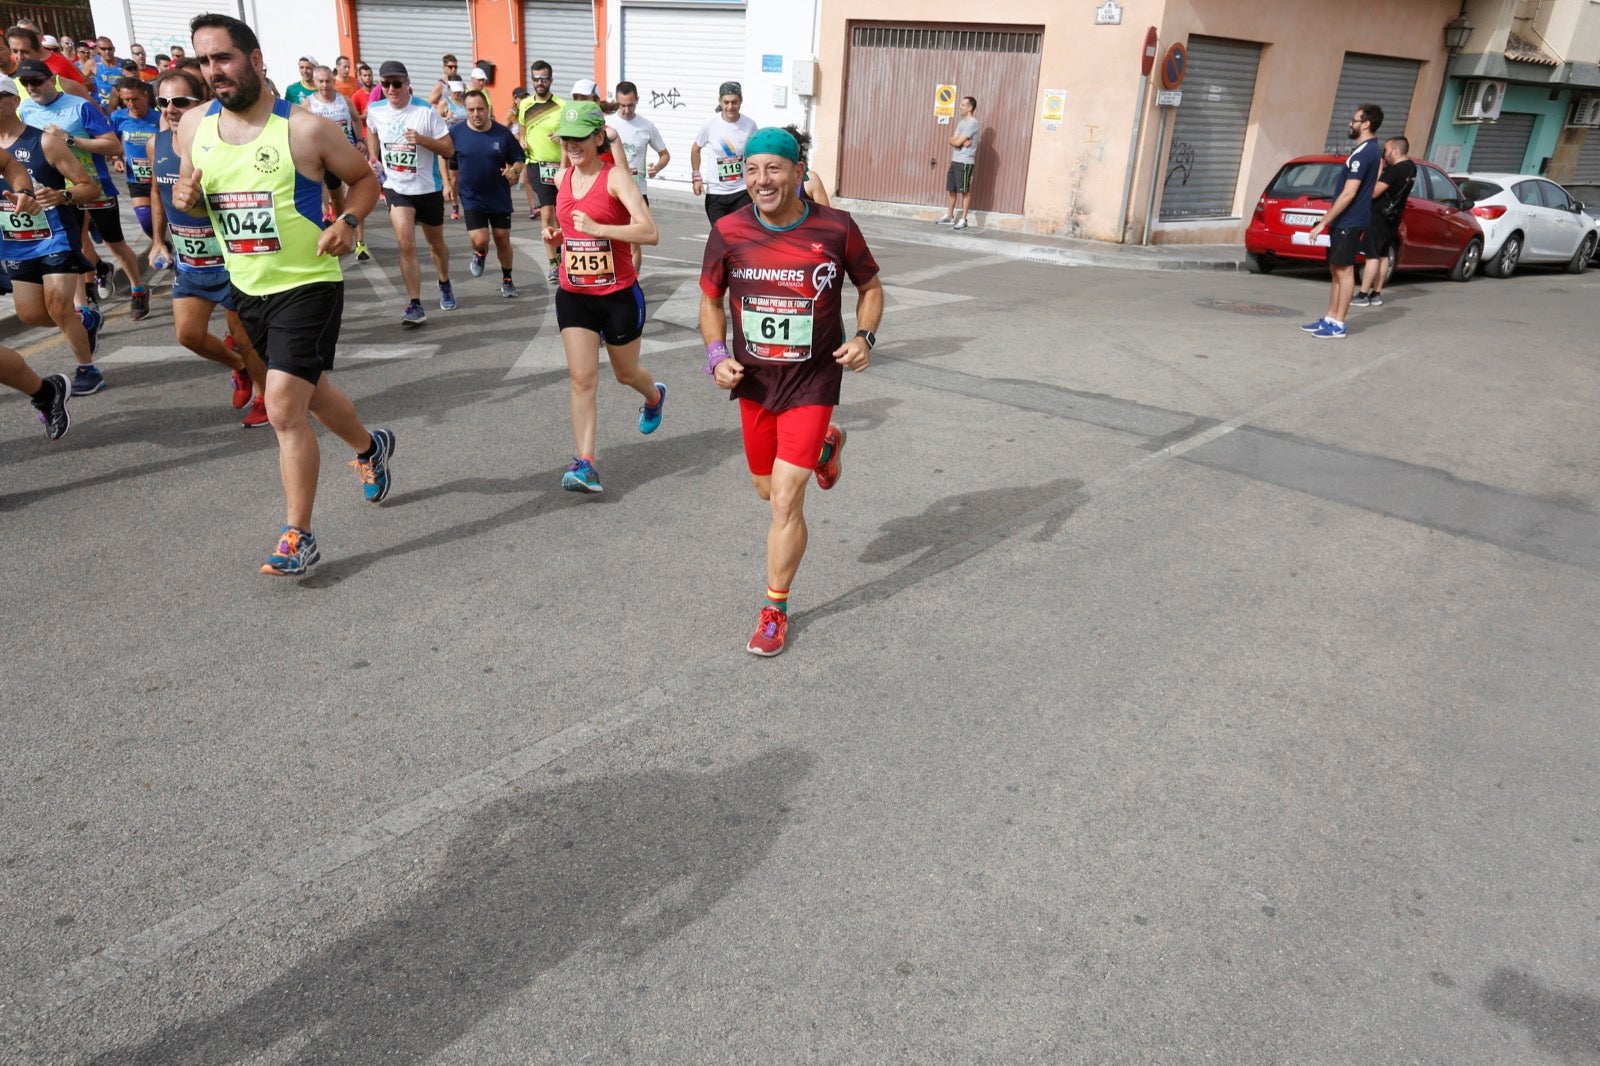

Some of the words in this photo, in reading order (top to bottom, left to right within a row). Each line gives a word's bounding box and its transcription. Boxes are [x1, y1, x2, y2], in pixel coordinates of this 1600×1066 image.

[138, 166, 152, 176] 65
[723, 163, 741, 174] 119
[10, 213, 33, 228] 63
[218, 212, 274, 235] 1042
[184, 239, 208, 255] 52
[571, 255, 608, 270] 2151
[770, 299, 787, 307] PREMIO
[761, 317, 790, 340] 61
